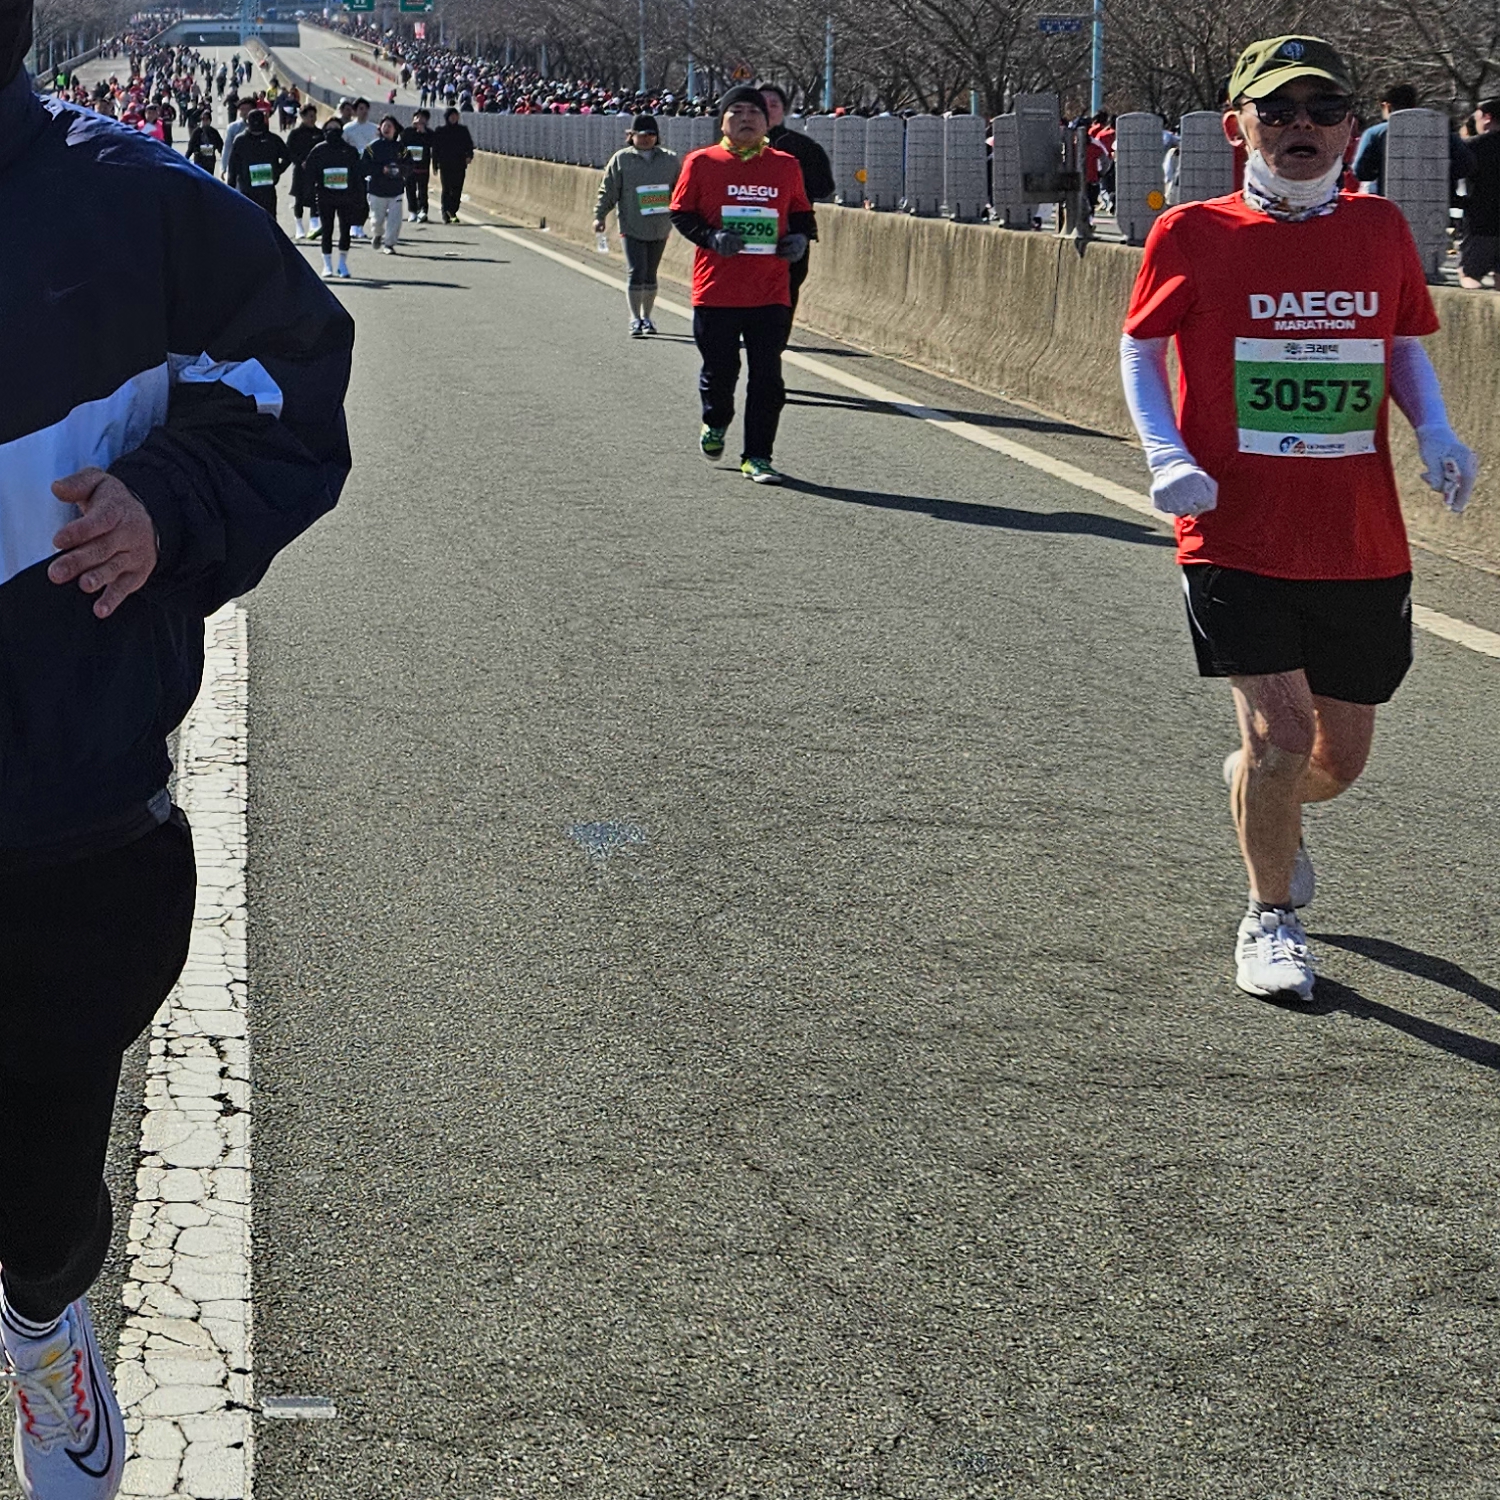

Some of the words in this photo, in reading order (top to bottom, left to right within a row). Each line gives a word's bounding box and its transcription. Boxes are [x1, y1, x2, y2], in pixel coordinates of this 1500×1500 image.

[727, 185, 779, 197] DAEGU
[1249, 291, 1379, 319] DAEGU
[1274, 320, 1356, 331] MARATHON
[1249, 378, 1373, 413] 30573
